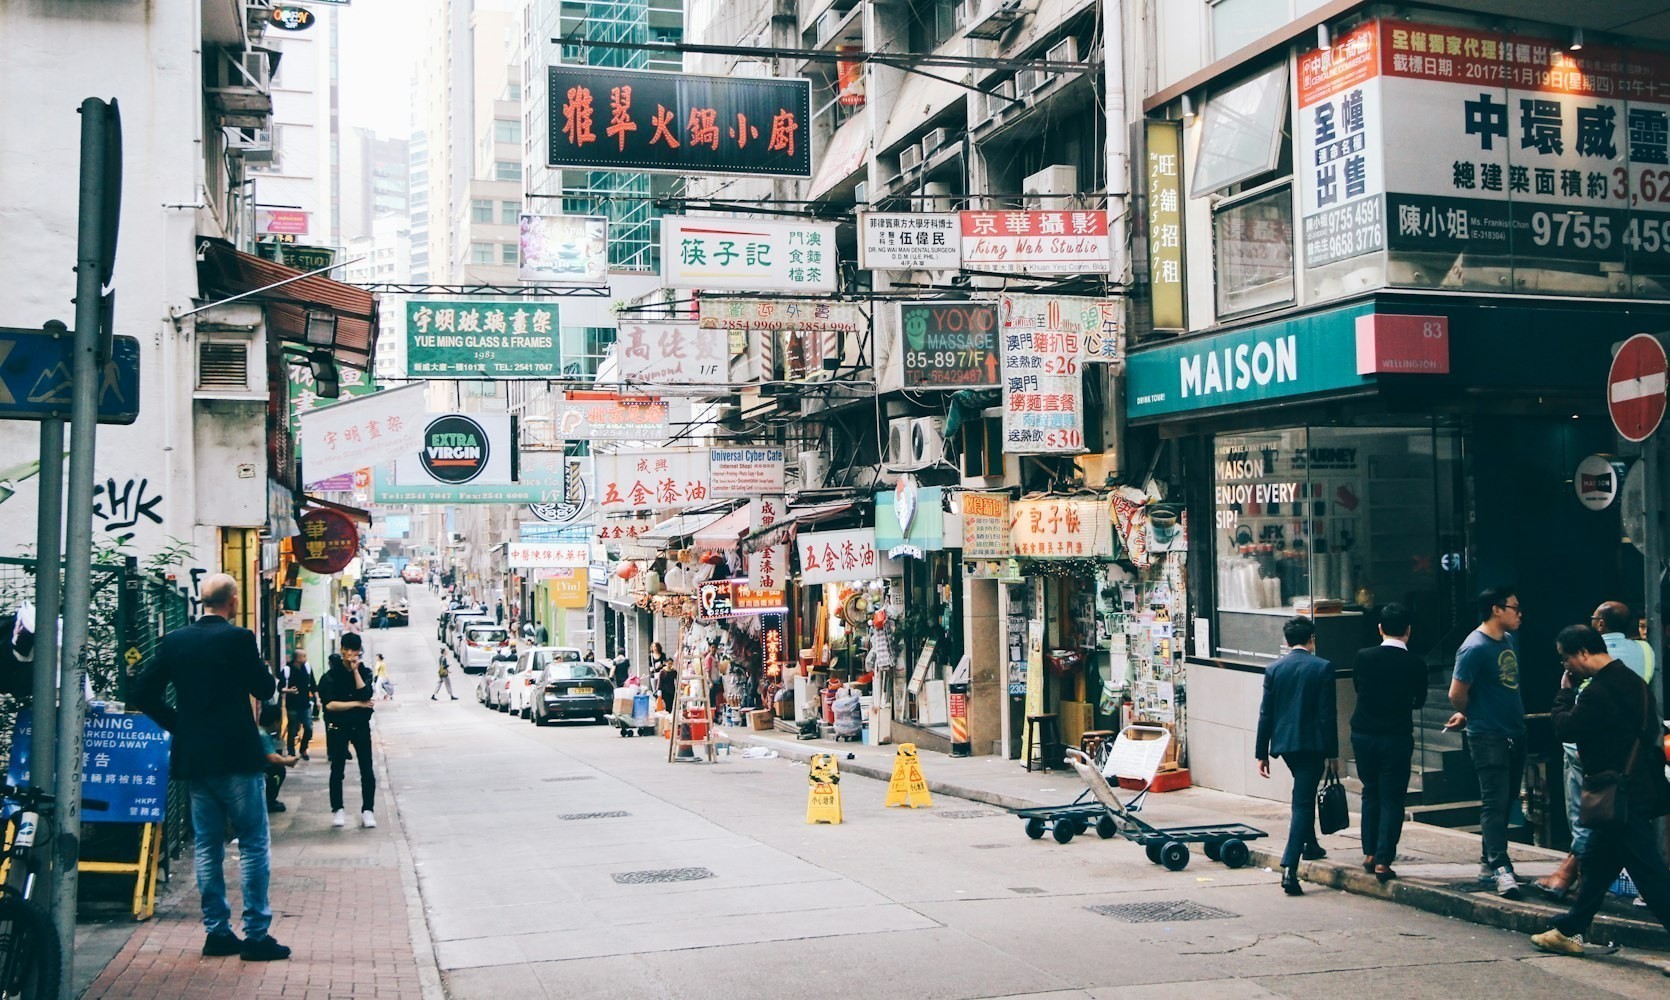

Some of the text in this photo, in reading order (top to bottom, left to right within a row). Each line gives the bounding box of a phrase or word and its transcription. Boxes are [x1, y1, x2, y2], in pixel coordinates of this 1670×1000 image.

[274, 9, 309, 23] OPEN
[1317, 155, 1366, 208] 出售
[1453, 161, 1608, 200] 總建築面積約
[971, 212, 1098, 235] 京華攝影
[1329, 209, 1353, 234] 9755
[1355, 198, 1380, 227] 4591
[1398, 204, 1470, 240] 陳小姐
[1531, 211, 1612, 250] 9755
[900, 231, 945, 246] 伍偉民
[1330, 233, 1353, 258] 9658
[1356, 224, 1381, 251] 3776
[680, 238, 772, 267] 筷子記
[975, 238, 1098, 260] King Wah Studio
[413, 305, 552, 335] 宇明玻璃畫架
[722, 319, 858, 332] 2854 9969 2854 9961
[933, 308, 994, 331] YOYO
[1098, 303, 1118, 358] 下午茶
[1423, 321, 1442, 339] 83
[414, 335, 552, 348] YUE MING GLASS & FRAMES
[928, 333, 994, 350] MASSAGE
[1006, 332, 1079, 353] 澳門豬扒包
[474, 350, 495, 360] 1983
[906, 351, 984, 368] 85-89 7/F
[1382, 359, 1437, 369] WELLINGTON
[514, 363, 533, 371] 2541
[534, 363, 553, 371] 7047
[700, 365, 718, 375] 1/F
[1006, 355, 1076, 375] 送熱飲 $26
[1180, 335, 1297, 398] MAISON
[1008, 375, 1038, 394] 澳門
[1009, 394, 1075, 412] 撈麵套餐
[431, 432, 478, 447] EXTRA
[1008, 429, 1080, 449] 送熱飲 $30
[1231, 445, 1244, 453] TAKE
[1244, 443, 1261, 452] AWAY
[1260, 441, 1277, 451] STYLE
[427, 445, 480, 460] VIRGIN
[711, 449, 783, 462] Universal Cyber Café
[1216, 459, 1264, 480] MAISON
[601, 477, 707, 506] 五金漆油
[1216, 482, 1297, 505] ENJOY EVERY
[1216, 510, 1238, 529] SIP!
[804, 540, 875, 572] 五金漆油
[84, 718, 133, 729] RNING
[119, 740, 148, 749] AWAY
